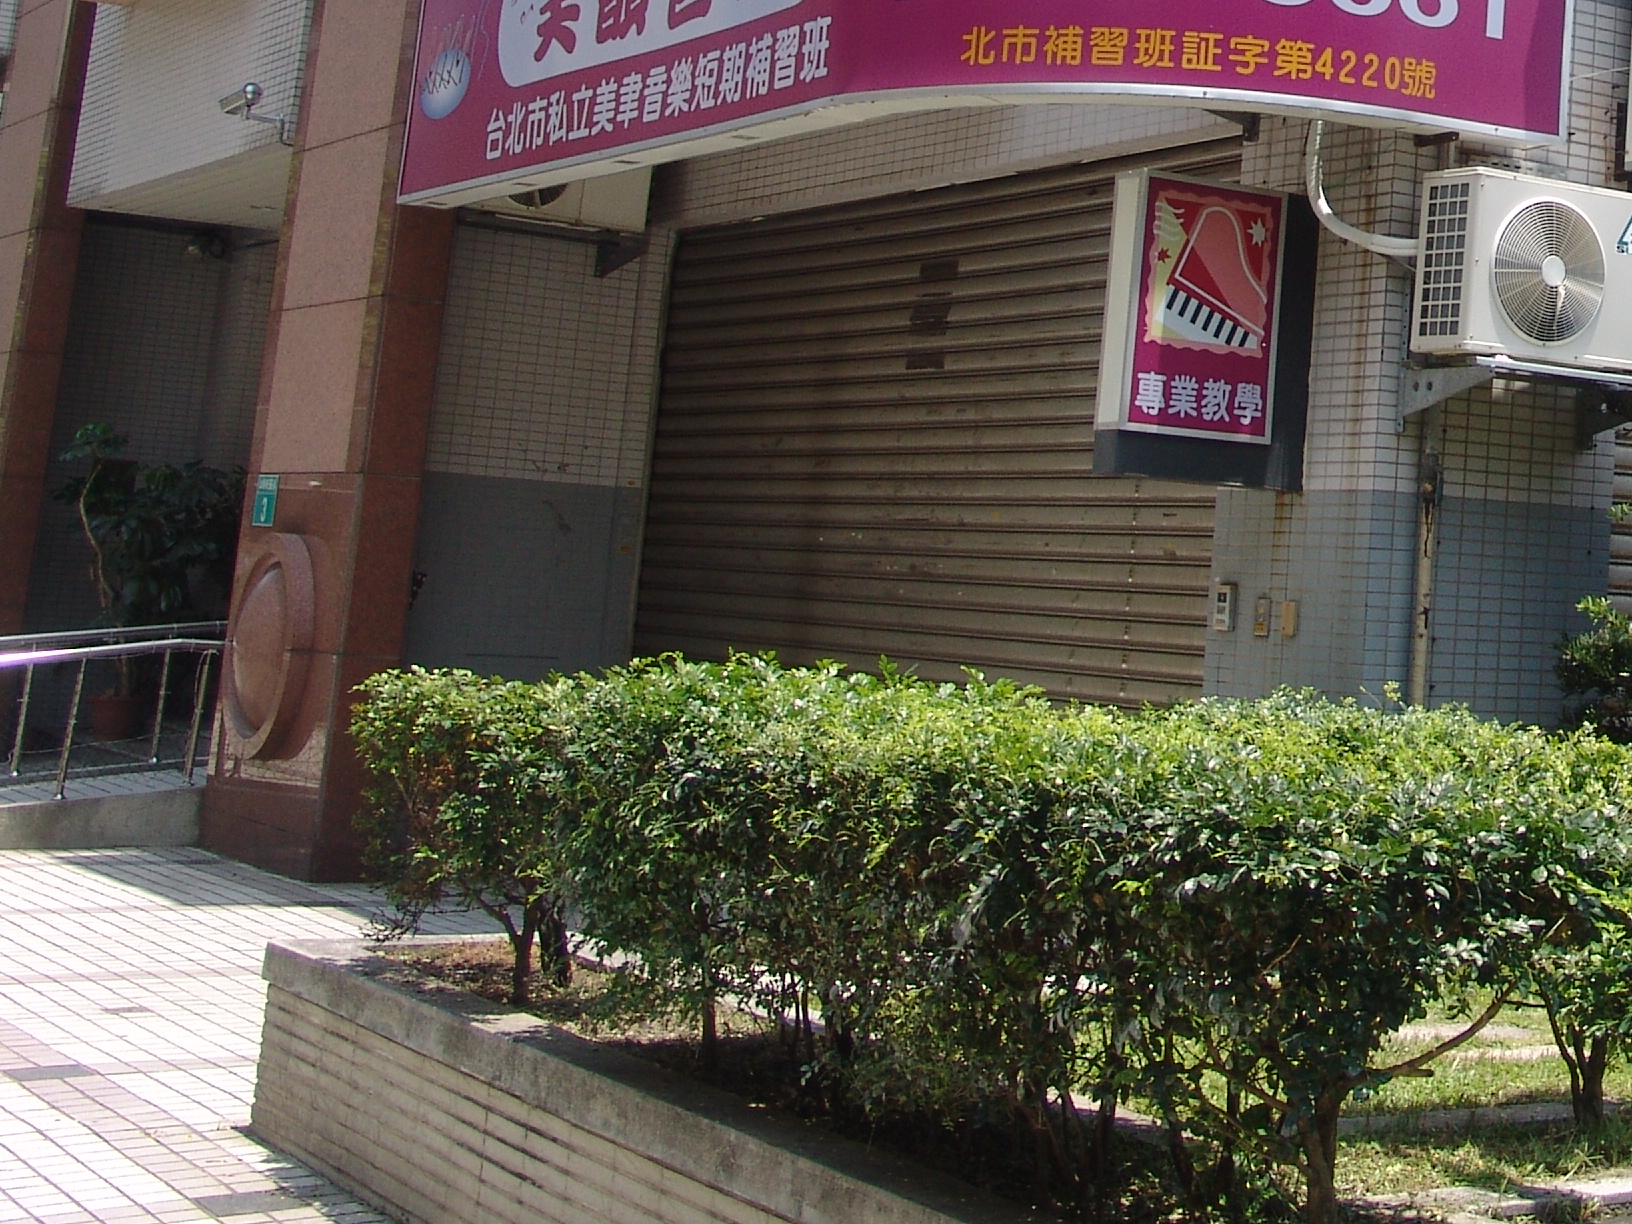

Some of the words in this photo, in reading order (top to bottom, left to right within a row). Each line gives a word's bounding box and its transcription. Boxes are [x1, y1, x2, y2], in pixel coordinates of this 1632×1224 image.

[485, 16, 832, 161] 台北市私立美聿音樂短期補習班
[960, 25, 1437, 99] 北市補習班証字第4220號
[1134, 371, 1263, 426] 專業教學
